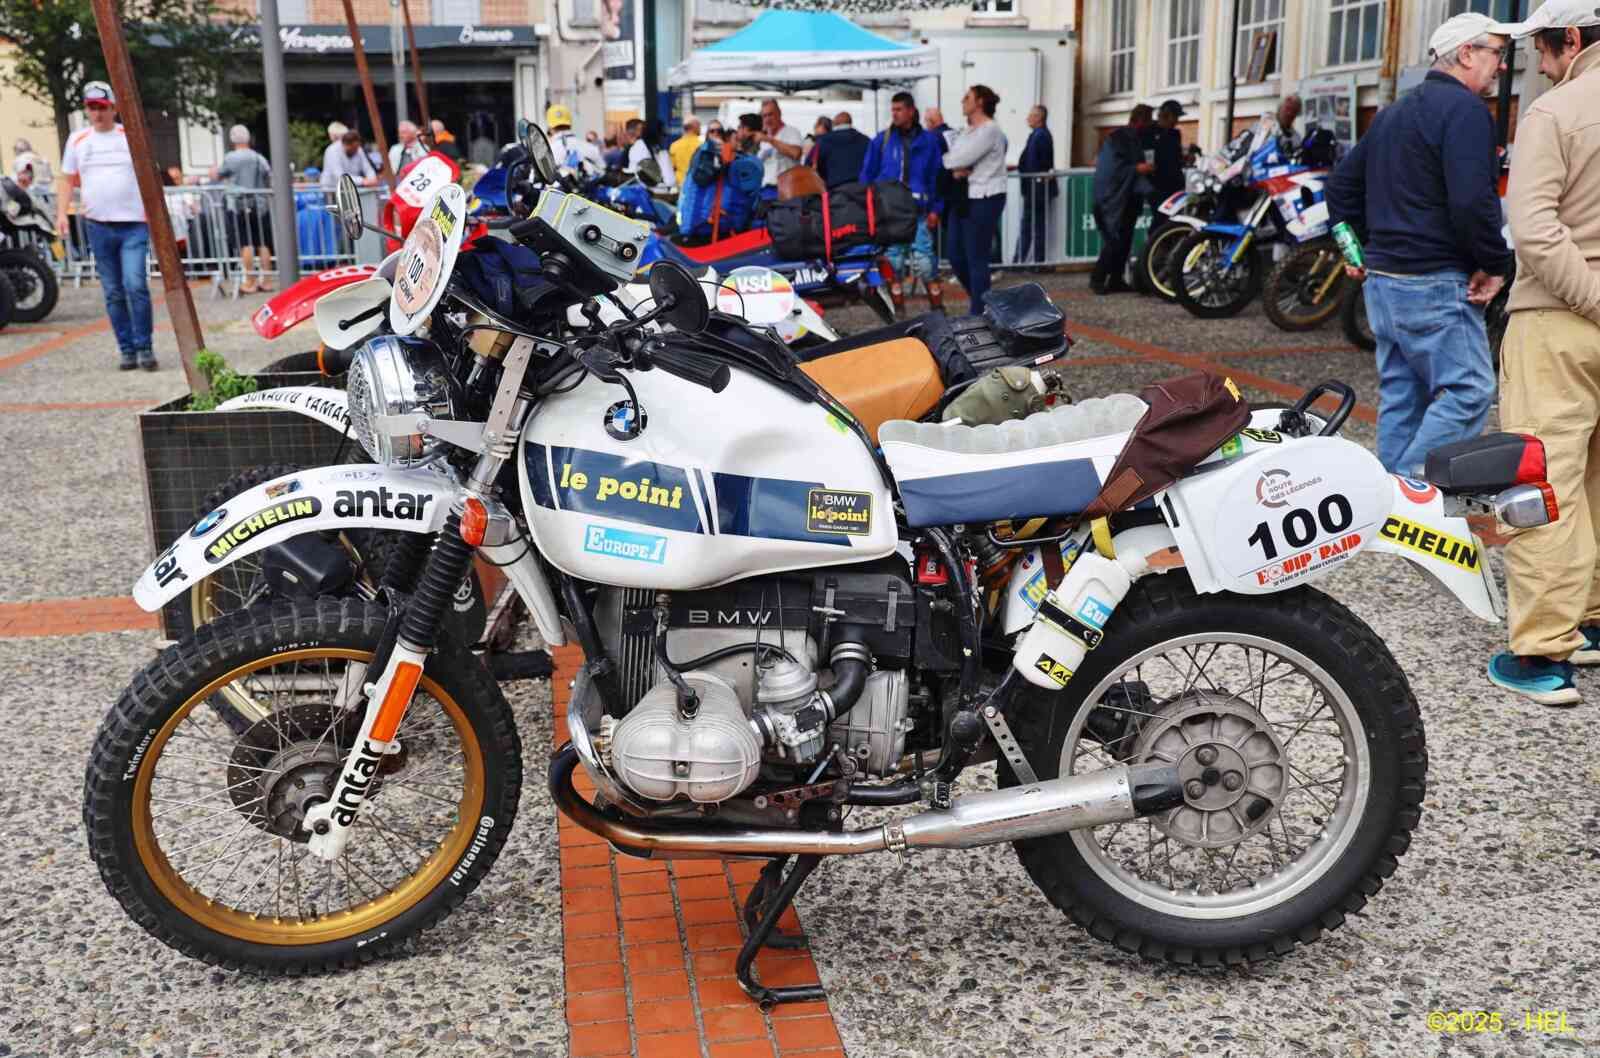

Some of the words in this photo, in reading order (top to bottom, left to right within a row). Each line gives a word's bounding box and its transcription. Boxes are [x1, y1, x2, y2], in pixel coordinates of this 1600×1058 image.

[410, 173, 431, 192] 28
[408, 254, 424, 284] 100
[333, 486, 433, 522] antar
[560, 463, 587, 490] le
[596, 478, 683, 510] point
[823, 495, 857, 506] BMW
[209, 500, 314, 561] MICHELIN
[1248, 493, 1354, 561] 100
[689, 610, 772, 625] BMW
[122, 728, 157, 782] Twinduro
[331, 741, 383, 829] antar
